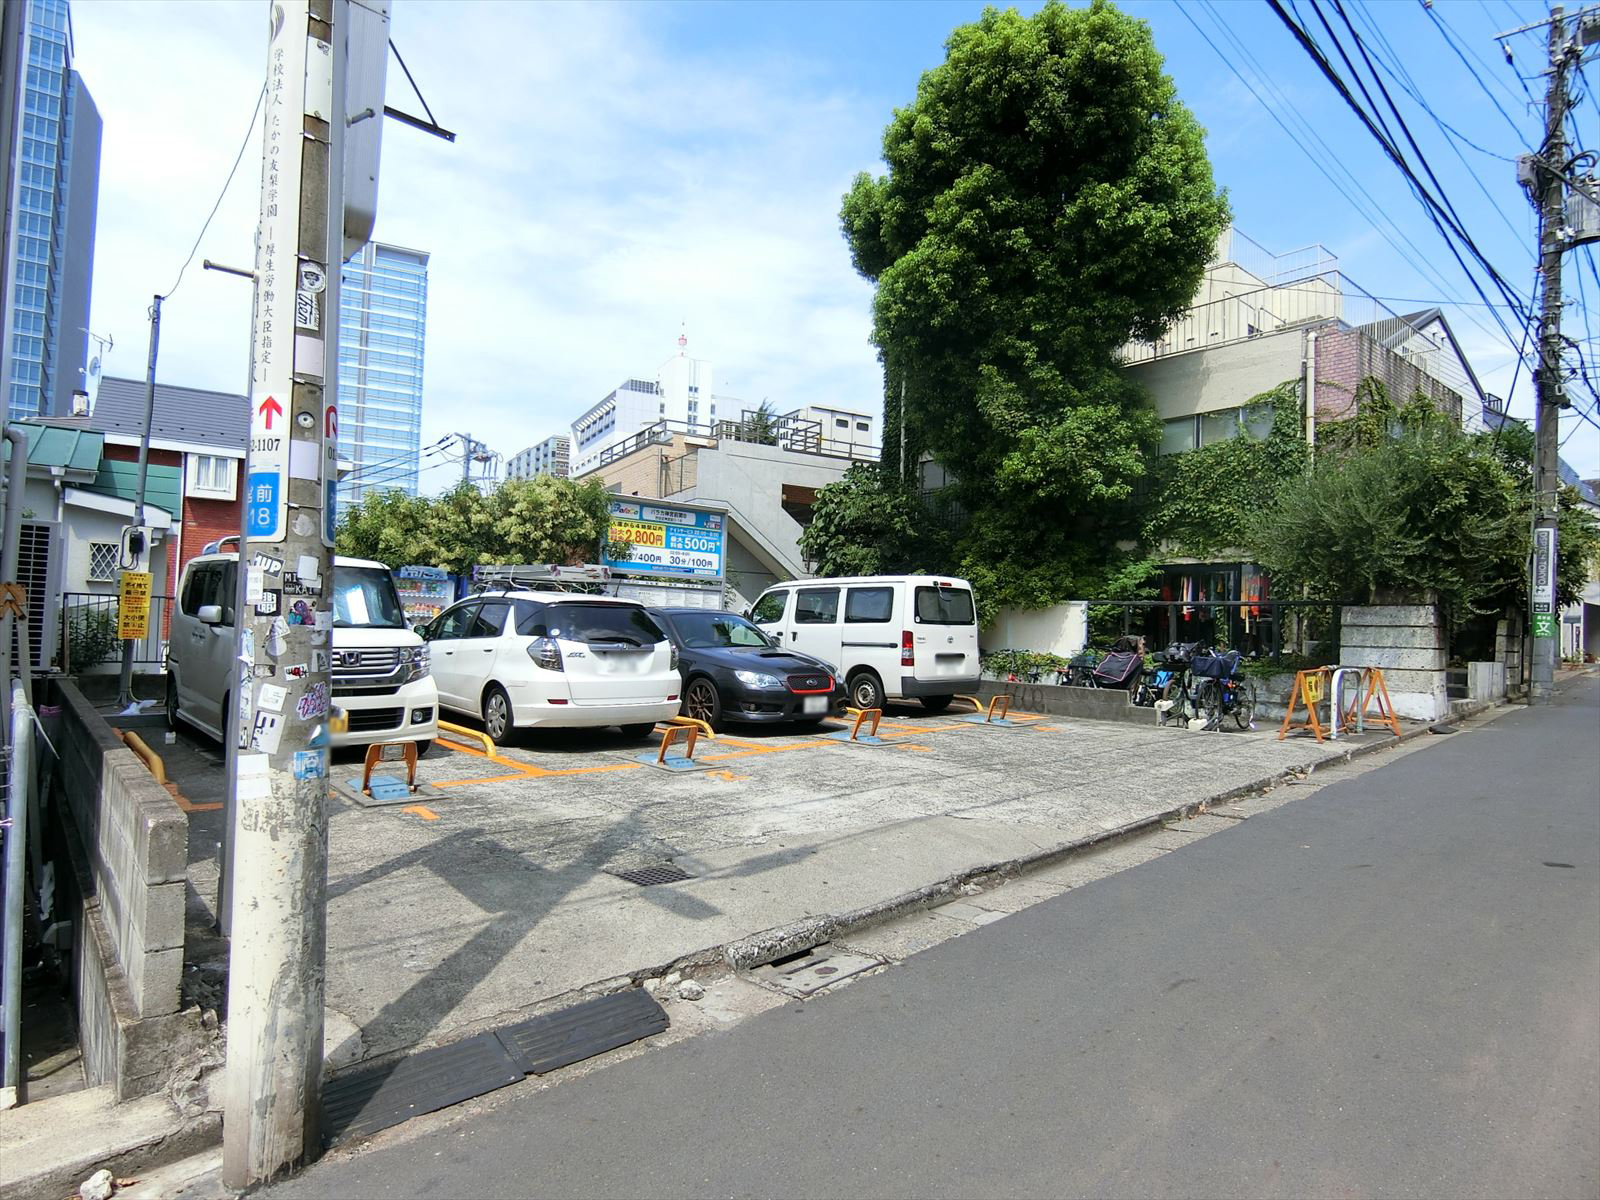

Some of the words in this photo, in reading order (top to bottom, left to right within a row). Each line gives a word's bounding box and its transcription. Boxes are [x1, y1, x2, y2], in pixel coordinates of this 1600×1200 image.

[272, 47, 285, 105] 学校法人
[684, 537, 716, 552] 500円
[669, 555, 713, 568] 30分/100円
